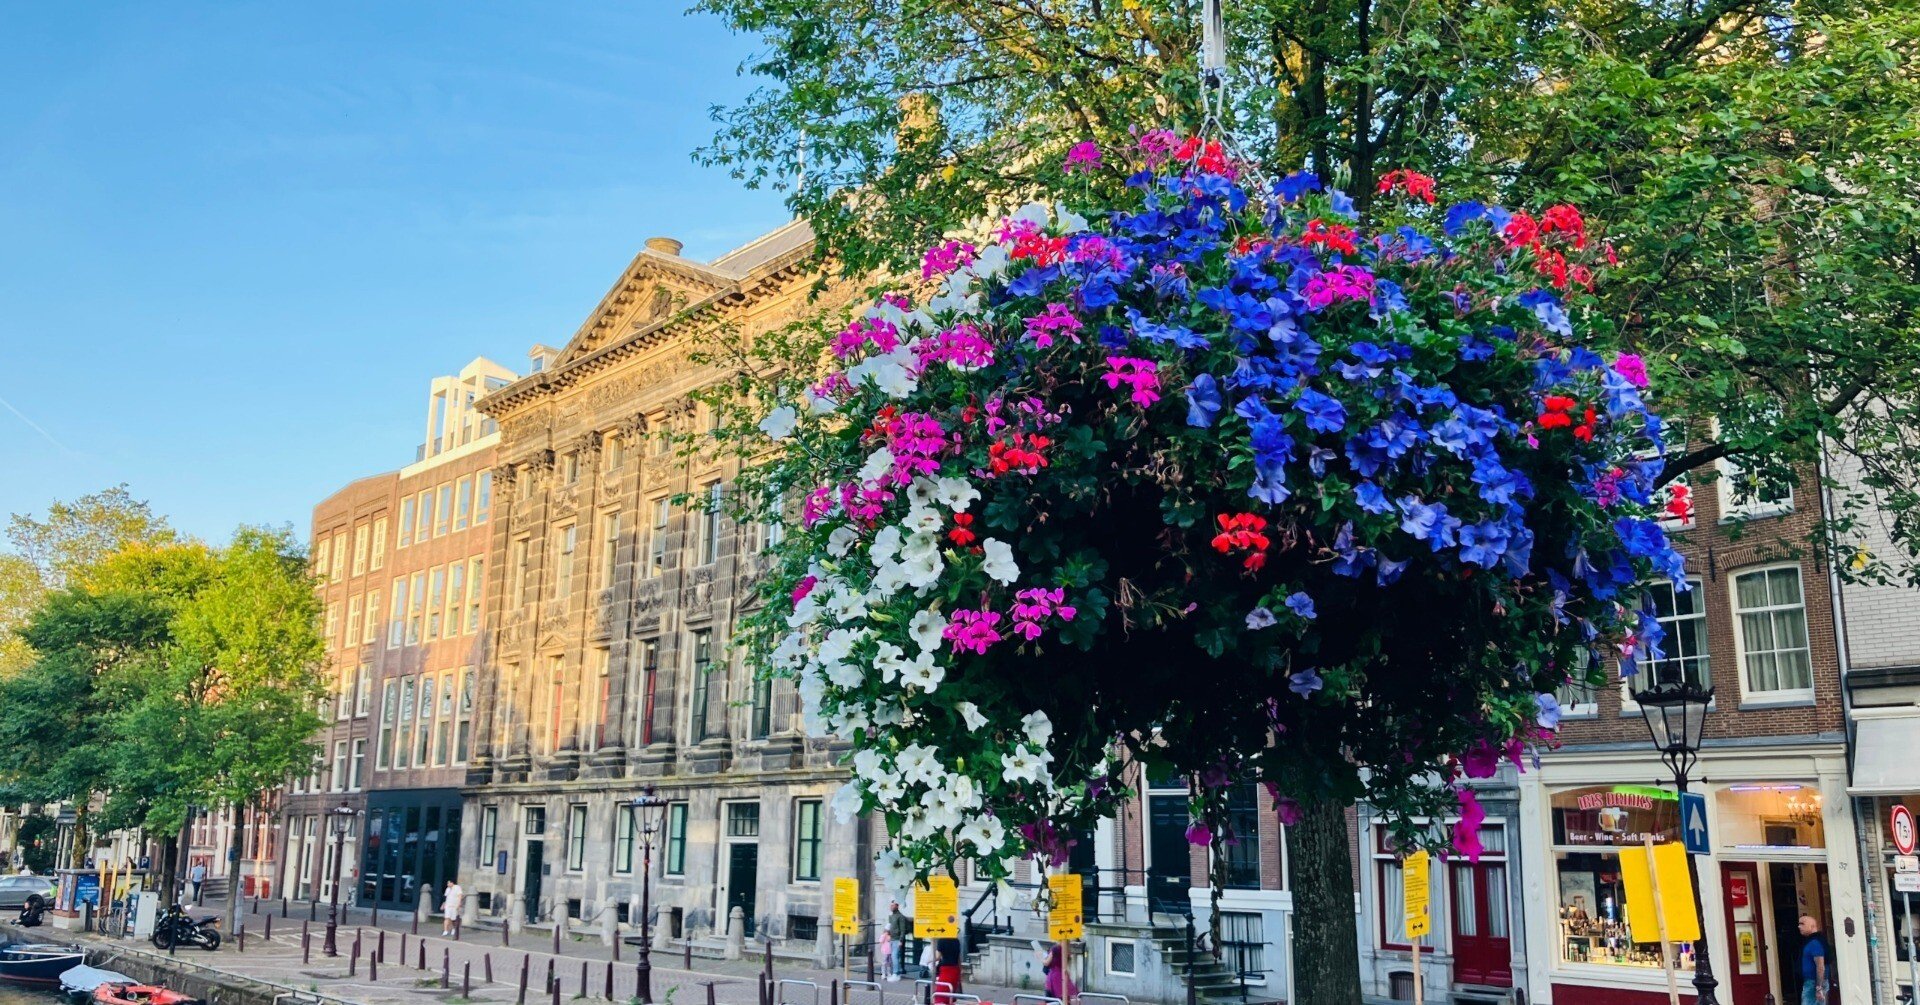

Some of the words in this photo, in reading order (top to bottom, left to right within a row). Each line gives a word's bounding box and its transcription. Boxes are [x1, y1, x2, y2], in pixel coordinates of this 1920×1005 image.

[1577, 793, 1603, 810] IRIS
[1606, 792, 1653, 810] DRINKS
[1640, 833, 1665, 841] Dnks
[142, 858, 149, 866] P
